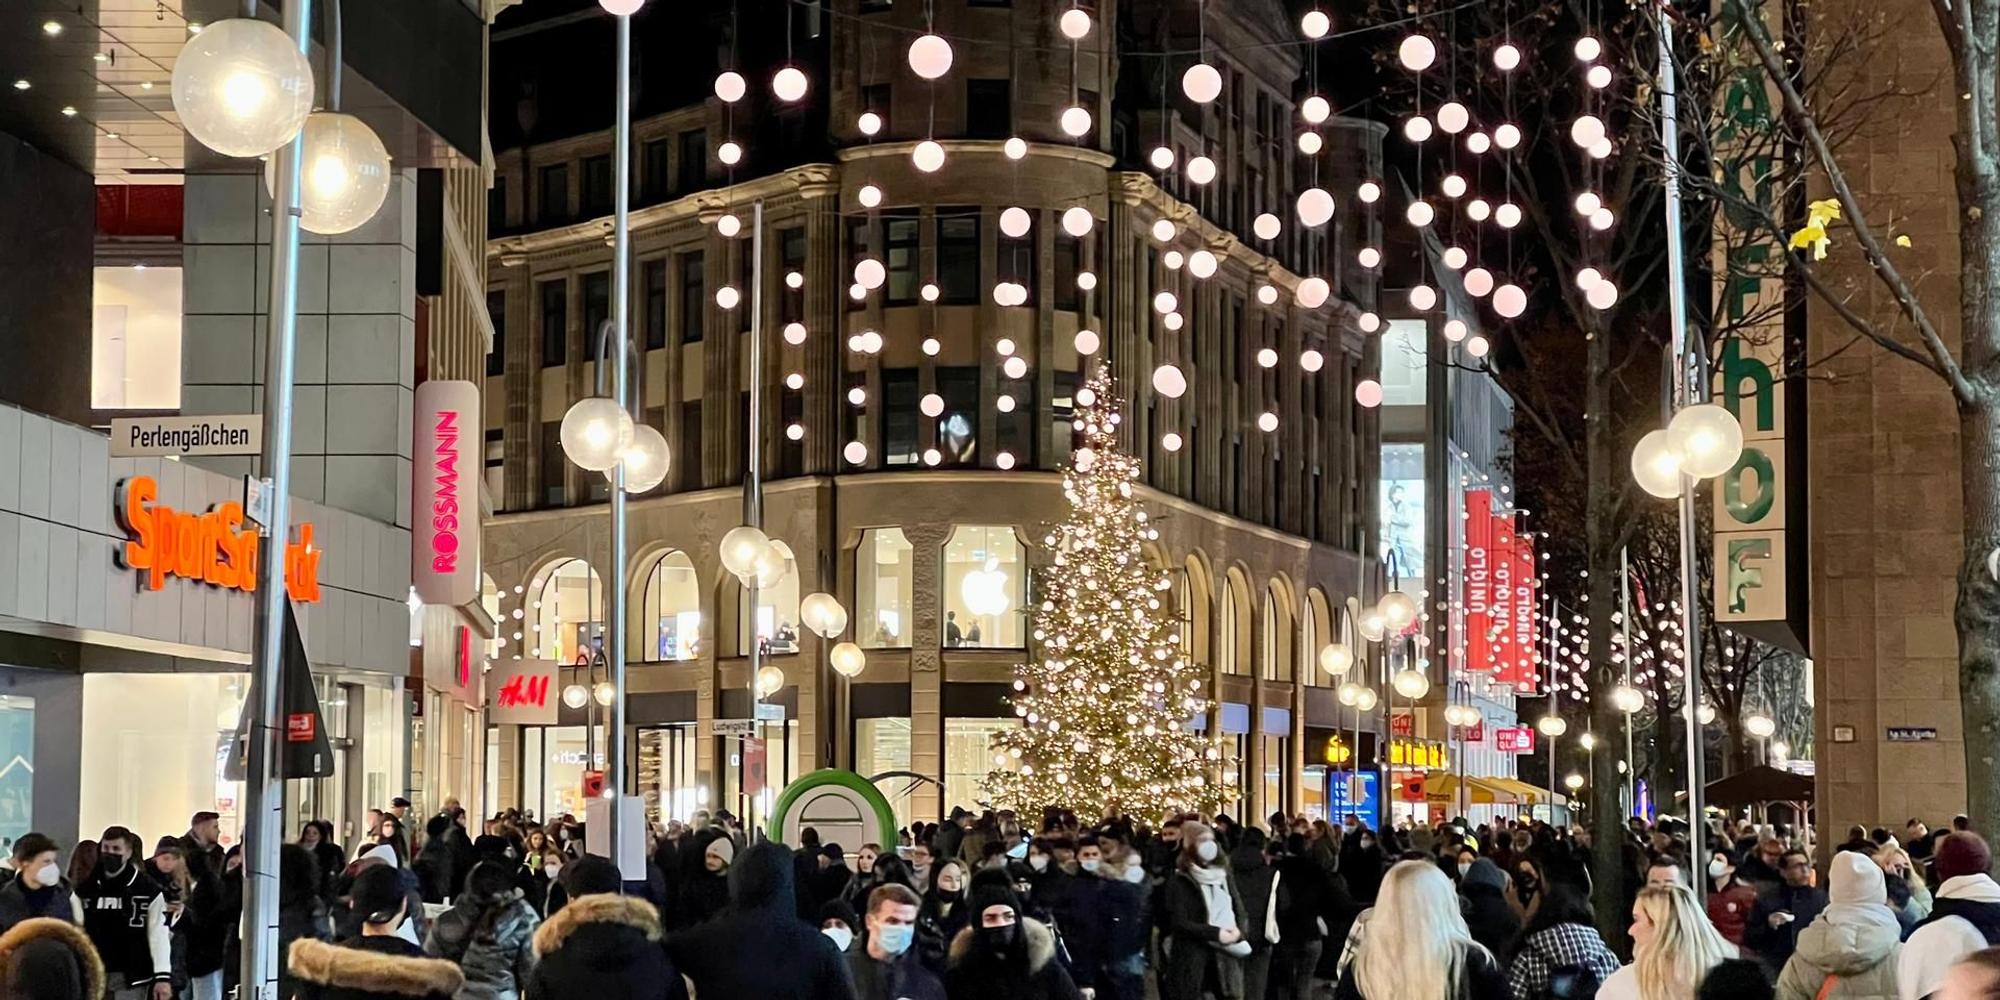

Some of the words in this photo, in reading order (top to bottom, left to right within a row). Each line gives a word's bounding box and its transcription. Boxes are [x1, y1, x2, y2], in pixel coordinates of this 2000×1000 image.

[131, 423, 249, 452] Perlengäßchen
[432, 411, 459, 574] ROSSMANN
[1471, 547, 1488, 613] UNIQLO
[1495, 569, 1511, 629] UNIQLO
[1516, 586, 1532, 644] UNIQLO
[1499, 731, 1515, 740] UNI
